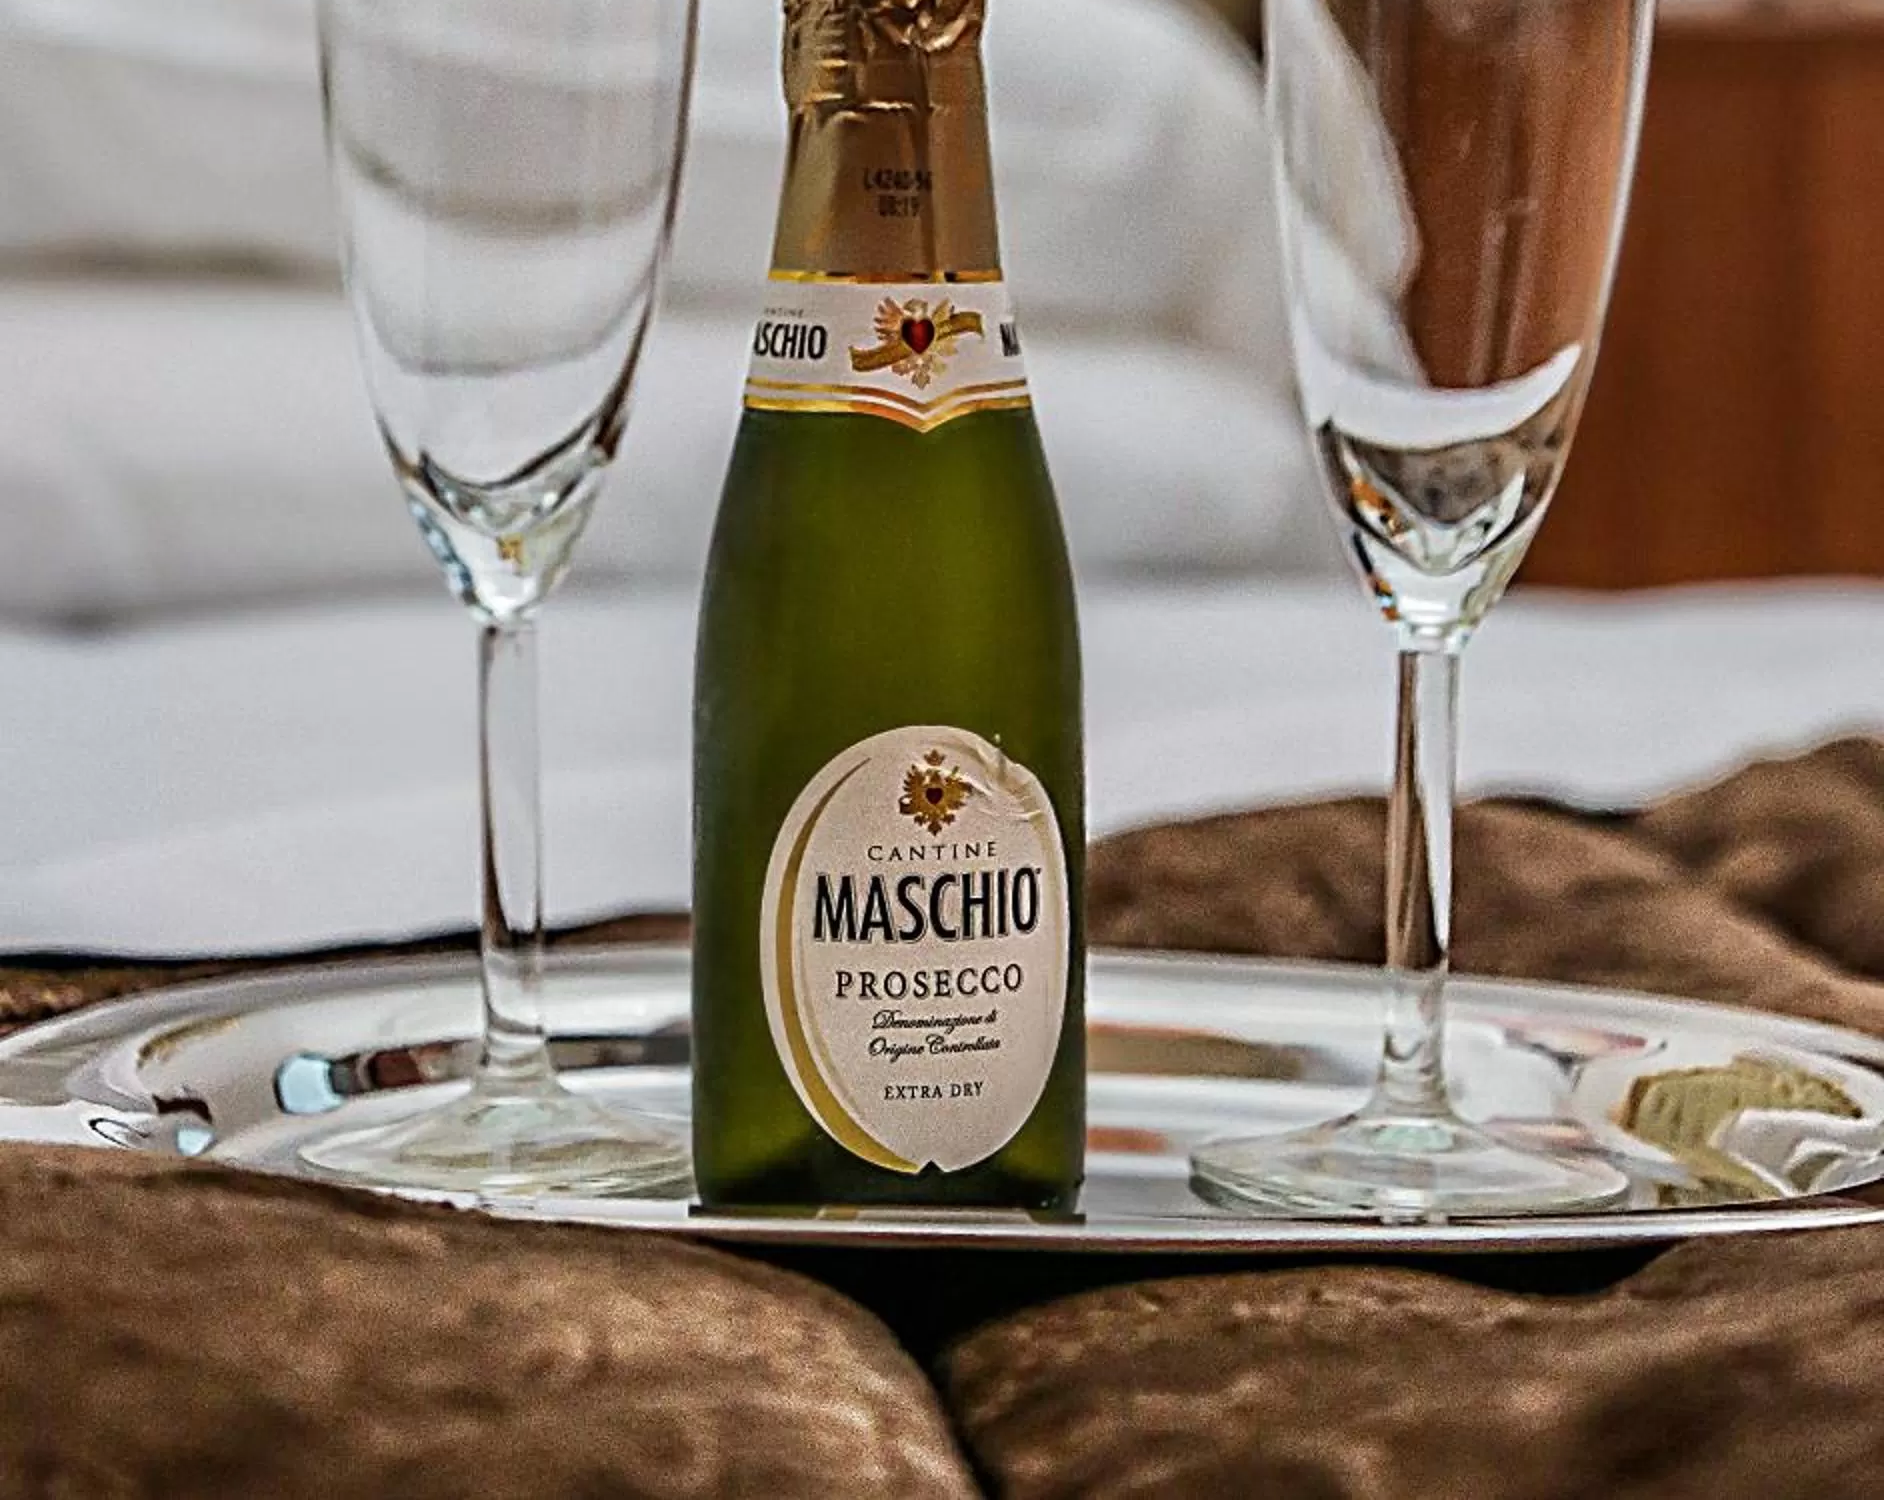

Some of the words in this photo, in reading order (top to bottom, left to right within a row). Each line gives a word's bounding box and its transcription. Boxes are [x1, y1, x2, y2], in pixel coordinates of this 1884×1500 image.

[867, 841, 998, 861] CANTINE
[814, 866, 1039, 943] MASCHIO
[835, 963, 1022, 999] PROSECCO
[871, 1009, 983, 1035] Denominazione
[868, 1036, 925, 1063] Origine
[925, 1033, 1001, 1055] Controllata
[884, 1085, 943, 1100] EXTRA
[950, 1081, 983, 1098] DRY
